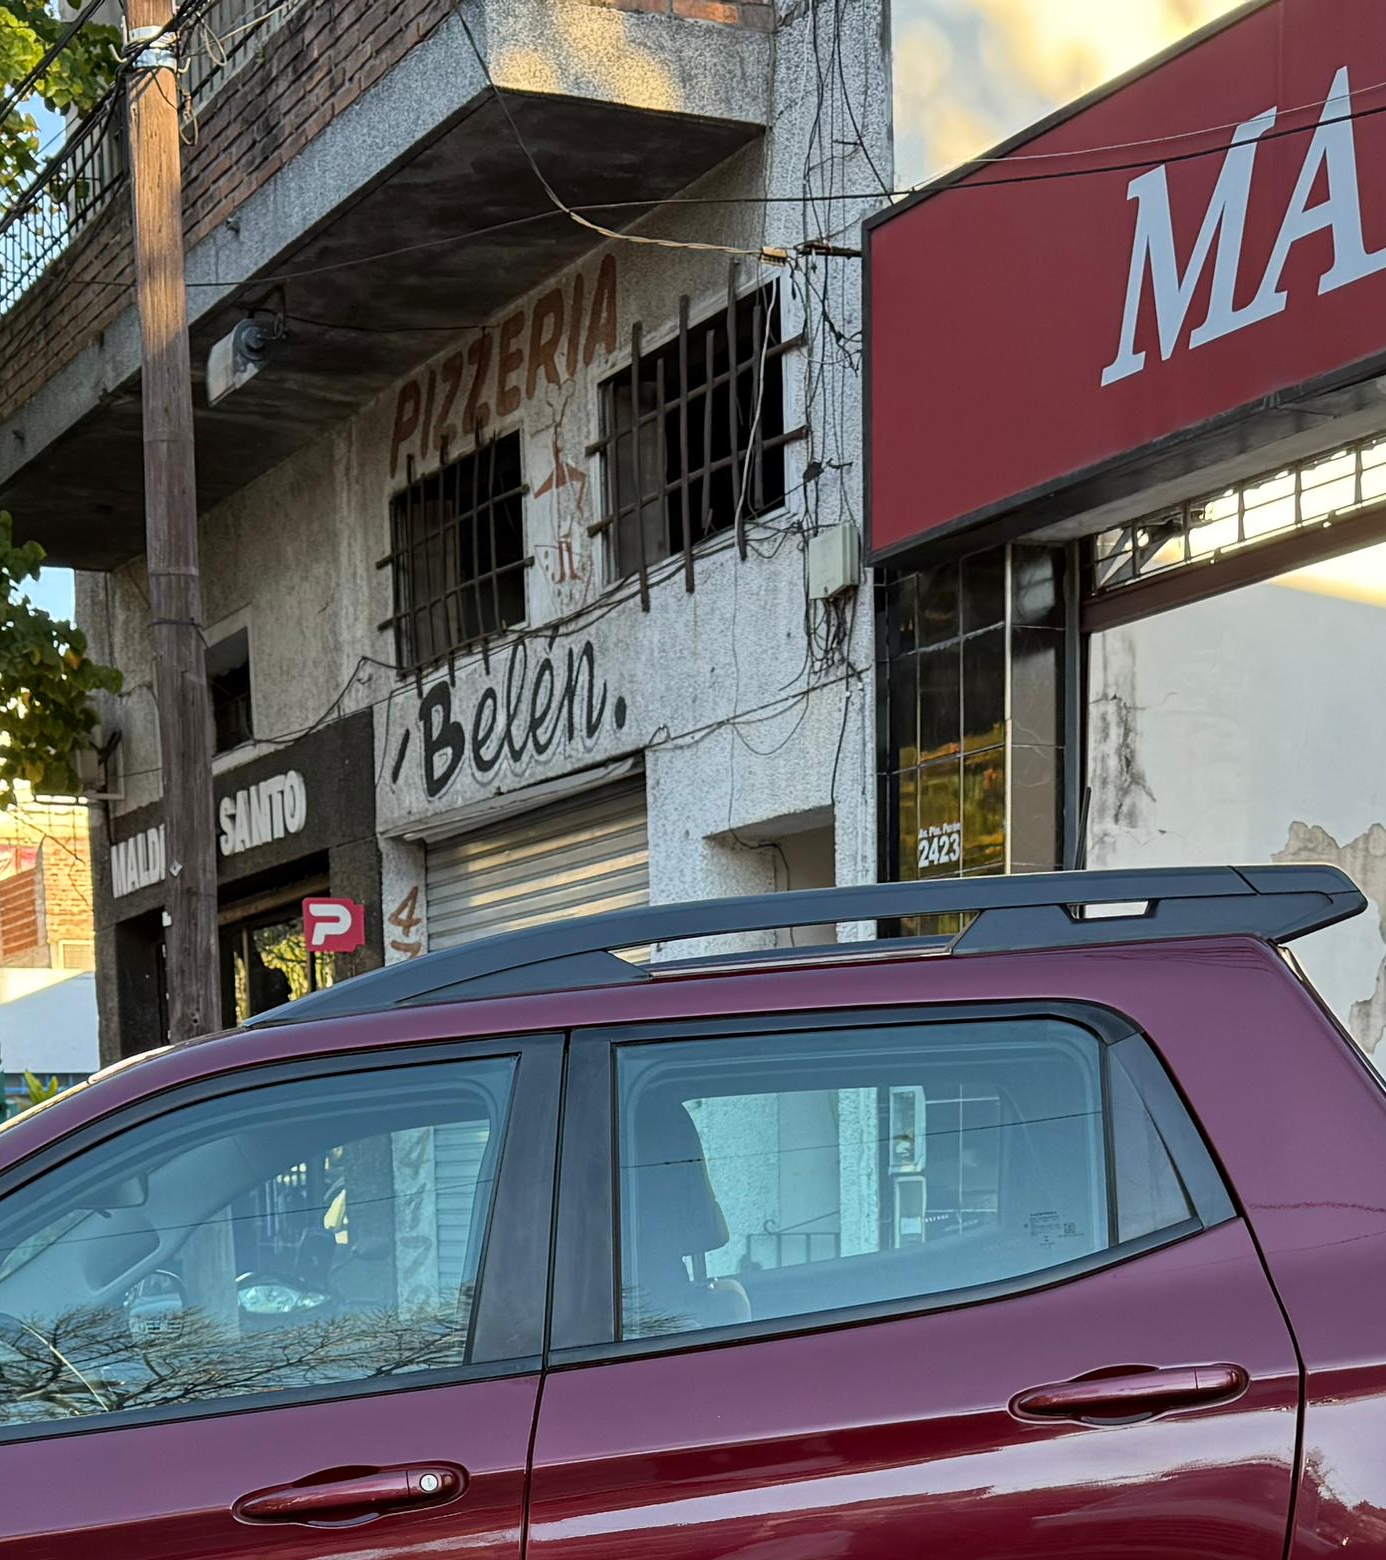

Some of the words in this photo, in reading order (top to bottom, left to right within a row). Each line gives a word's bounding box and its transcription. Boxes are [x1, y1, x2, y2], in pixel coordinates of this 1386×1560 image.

[389, 254, 615, 478] PIZZERIA
[111, 824, 166, 899] MALDI
[219, 770, 307, 857] SANTO
[918, 833, 960, 868] 2423
